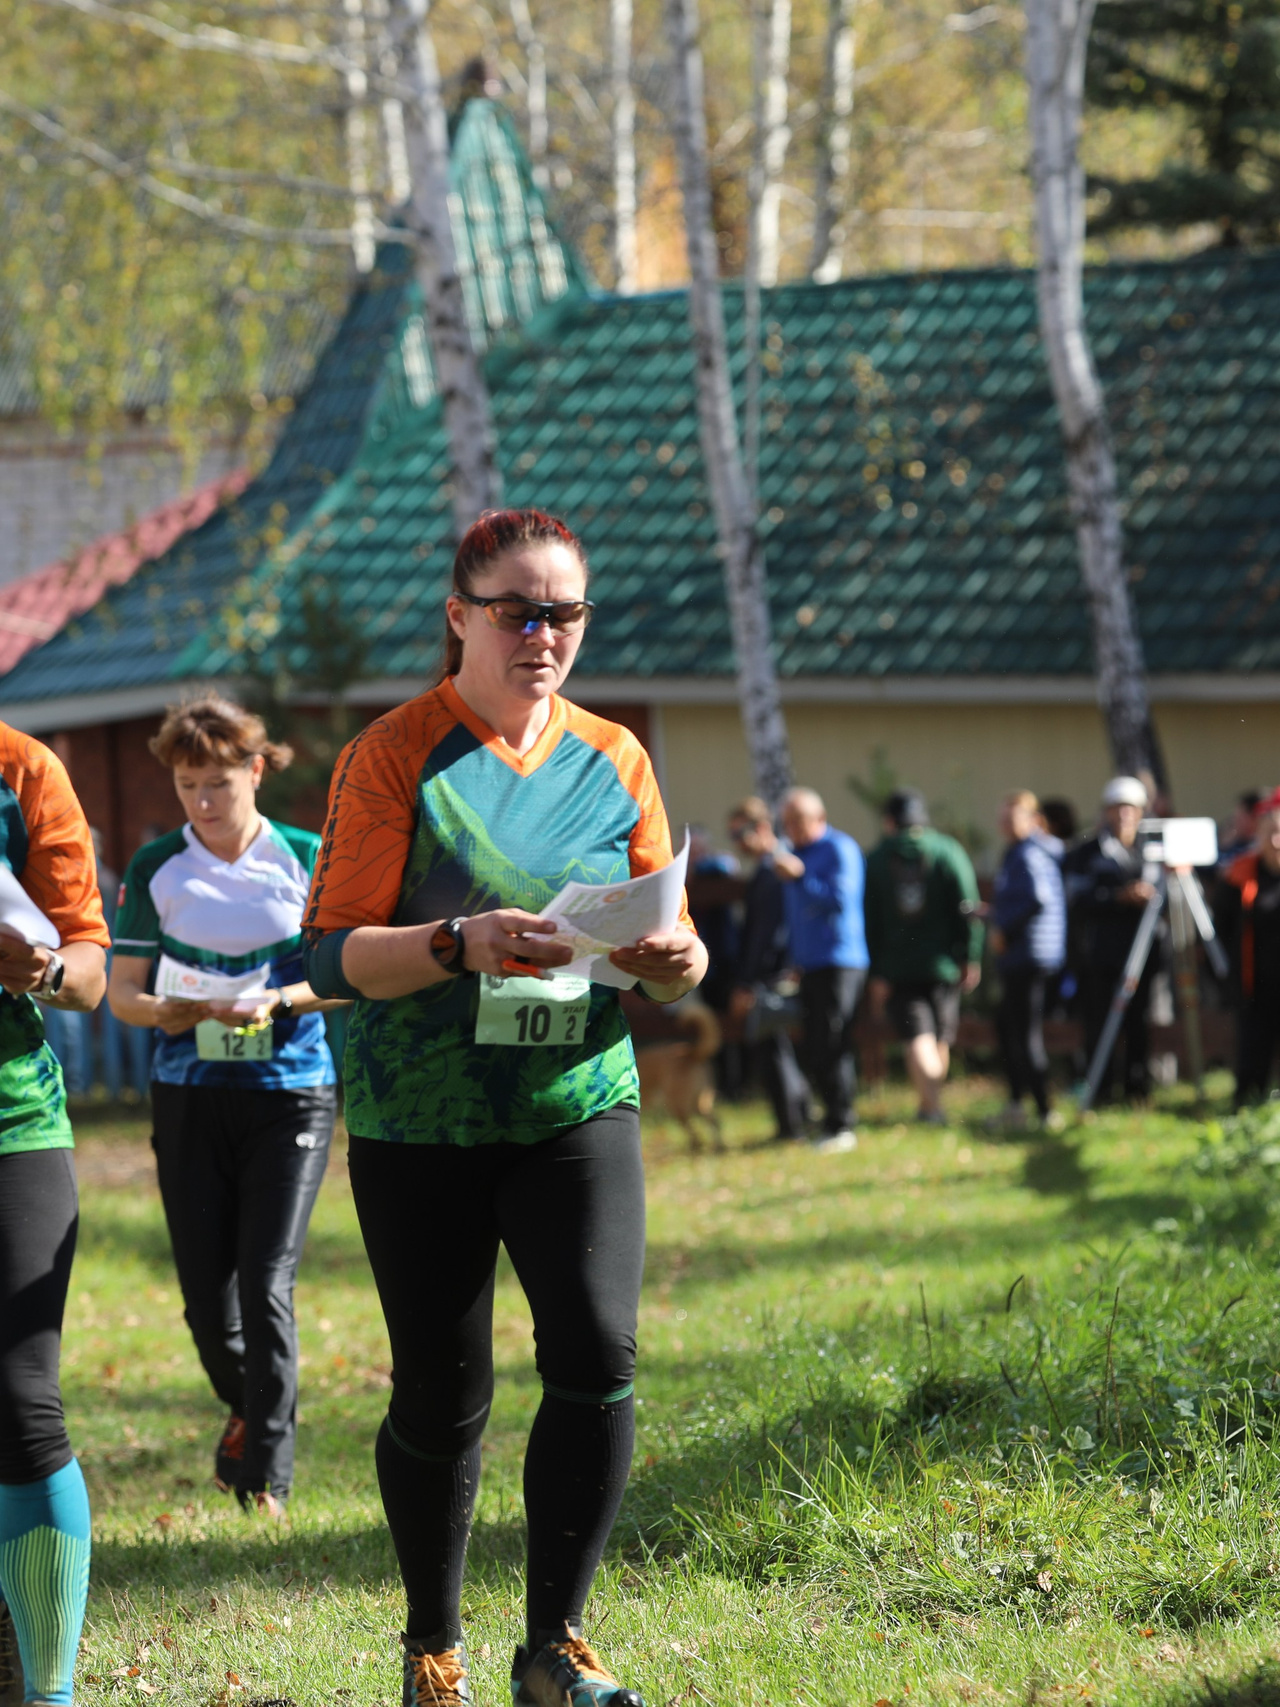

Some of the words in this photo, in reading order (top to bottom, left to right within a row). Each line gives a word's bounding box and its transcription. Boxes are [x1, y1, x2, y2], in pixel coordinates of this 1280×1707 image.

[563, 1006, 586, 1014] ЭТАП
[515, 1004, 551, 1043] 10
[564, 1015, 576, 1041] 2
[222, 1032, 245, 1056] 12
